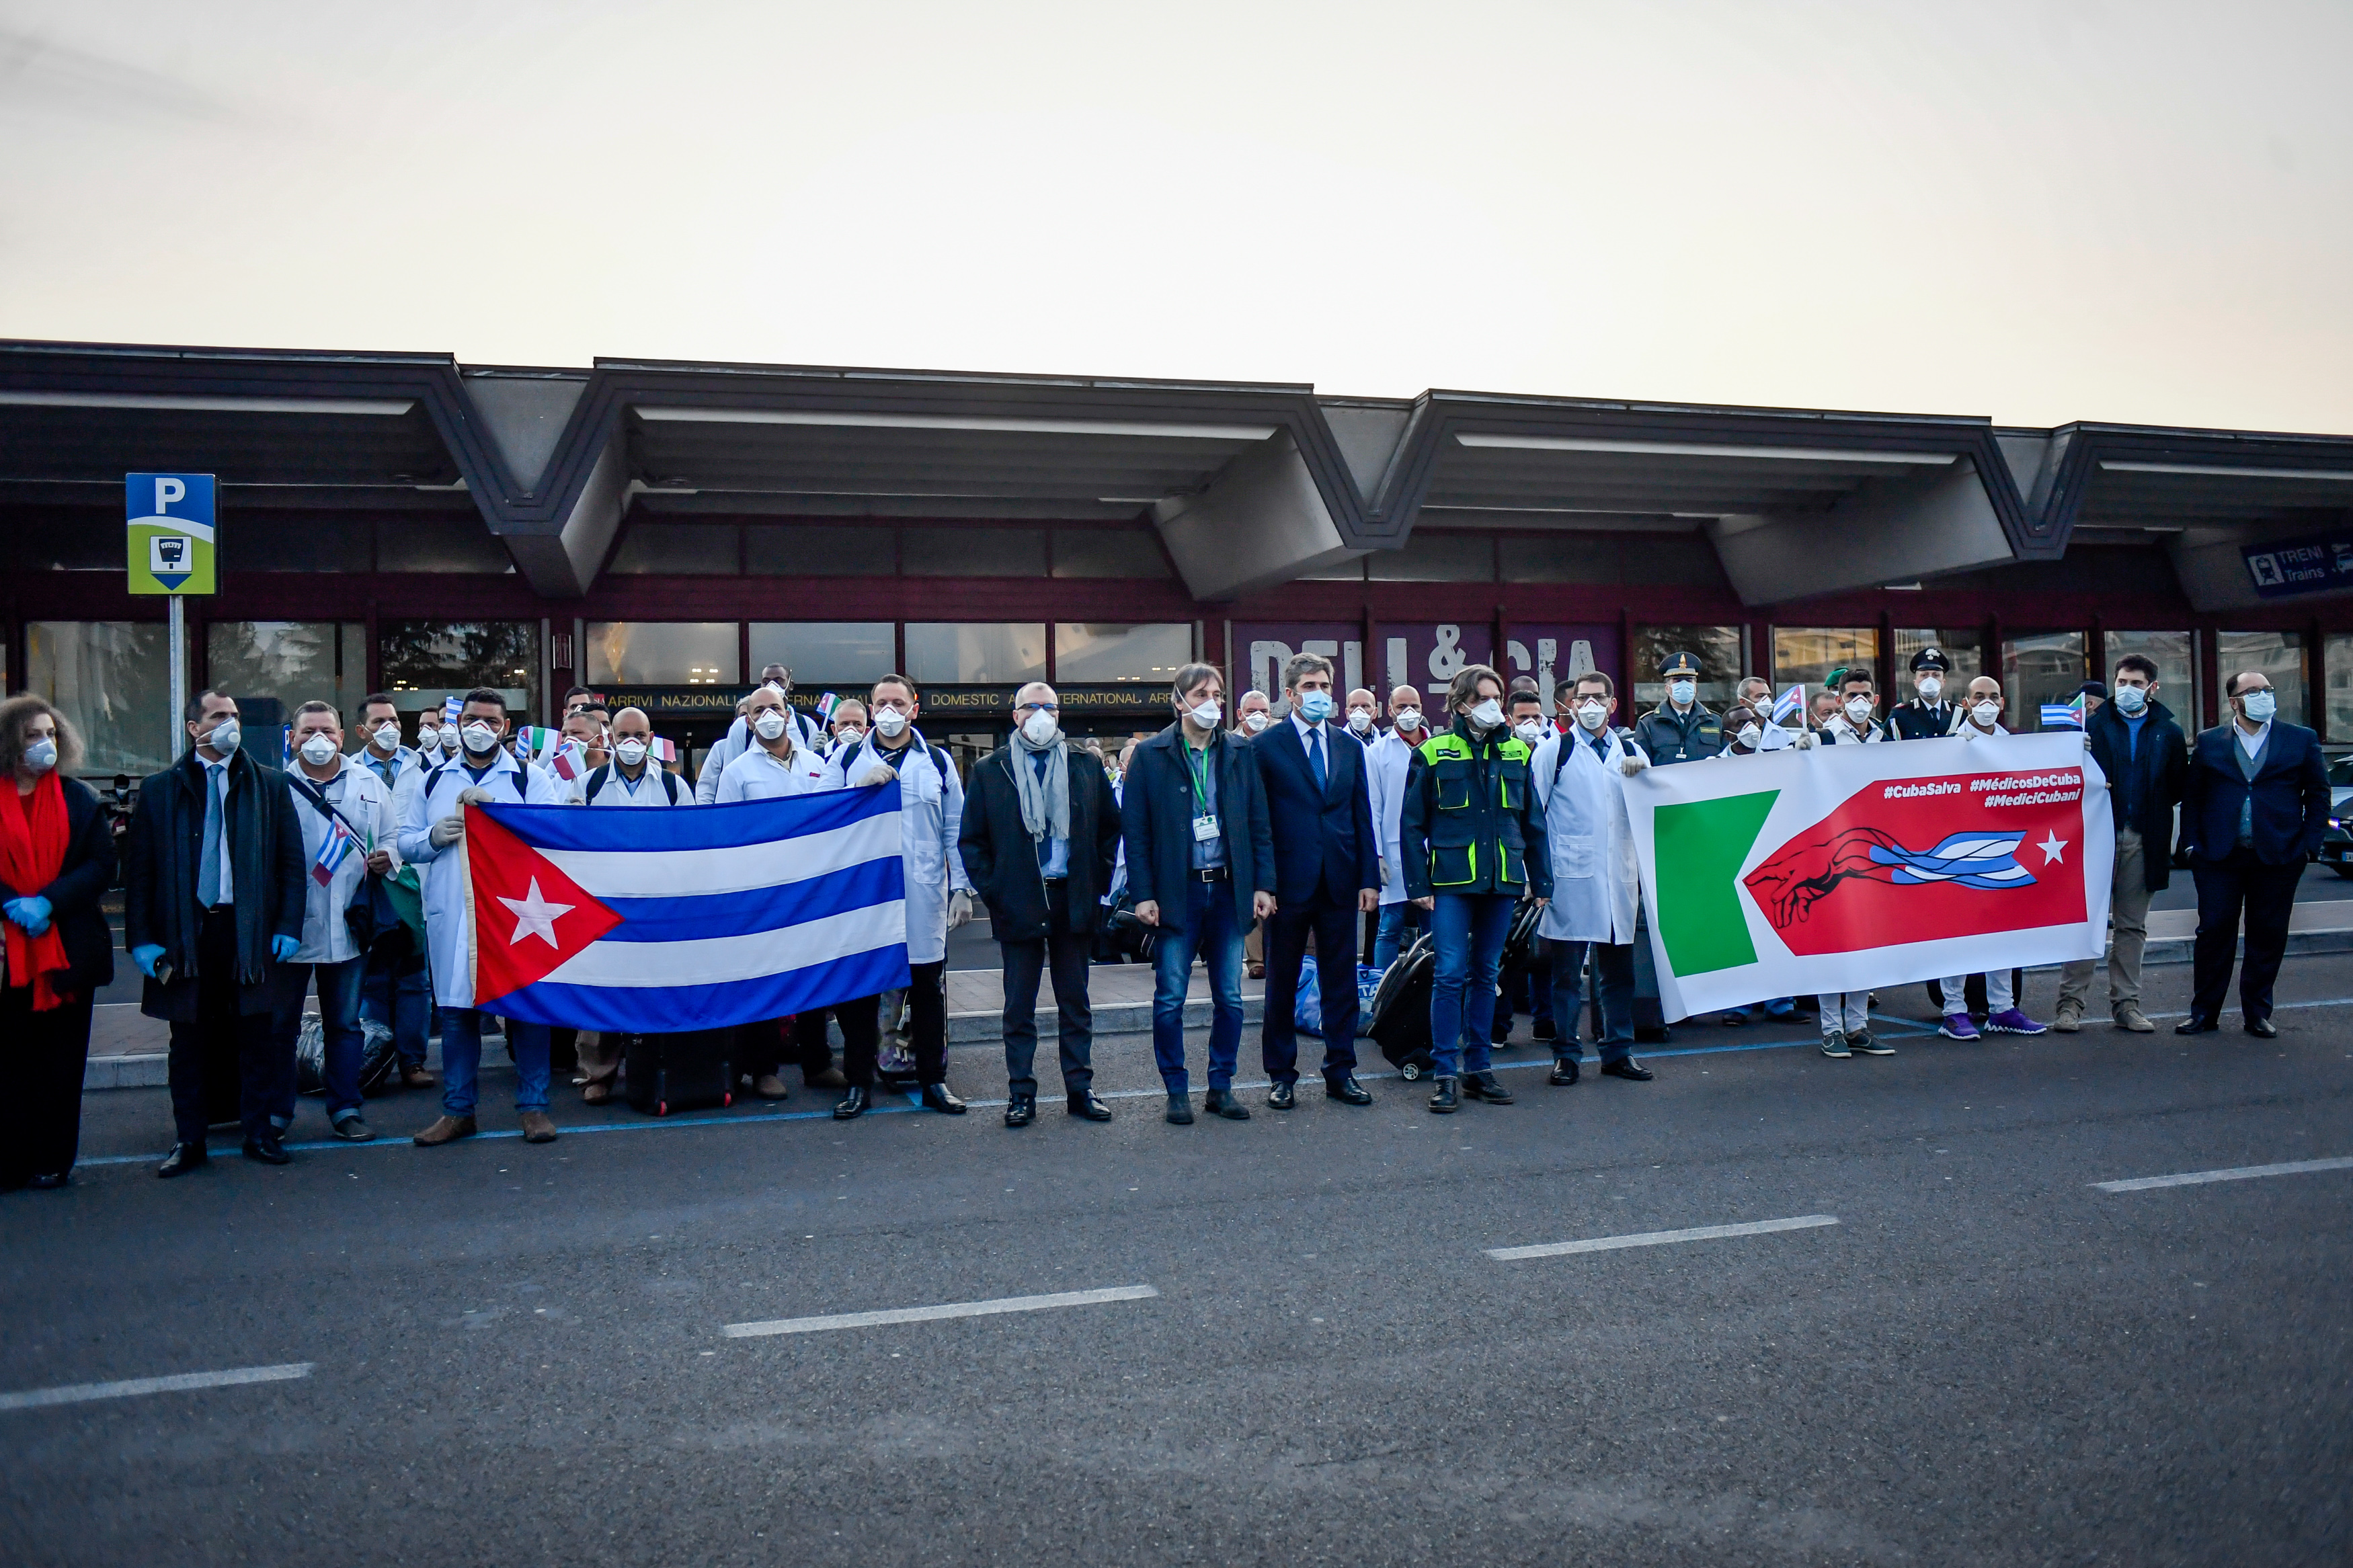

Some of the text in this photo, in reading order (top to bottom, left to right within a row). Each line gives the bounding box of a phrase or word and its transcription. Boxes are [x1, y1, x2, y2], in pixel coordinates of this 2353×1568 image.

[155, 477, 186, 514] P
[2276, 545, 2324, 565] TRENI
[2286, 567, 2325, 582] Trains
[608, 695, 653, 706] ARRIVI
[662, 695, 737, 706] NAZIONALI
[931, 694, 999, 706] DOMESTIC
[1056, 693, 1140, 704] TERNATIONAL
[1884, 773, 2081, 799] #CubaSalva #MédicosDeCuba
[1984, 788, 2082, 808] #MediciCubani
